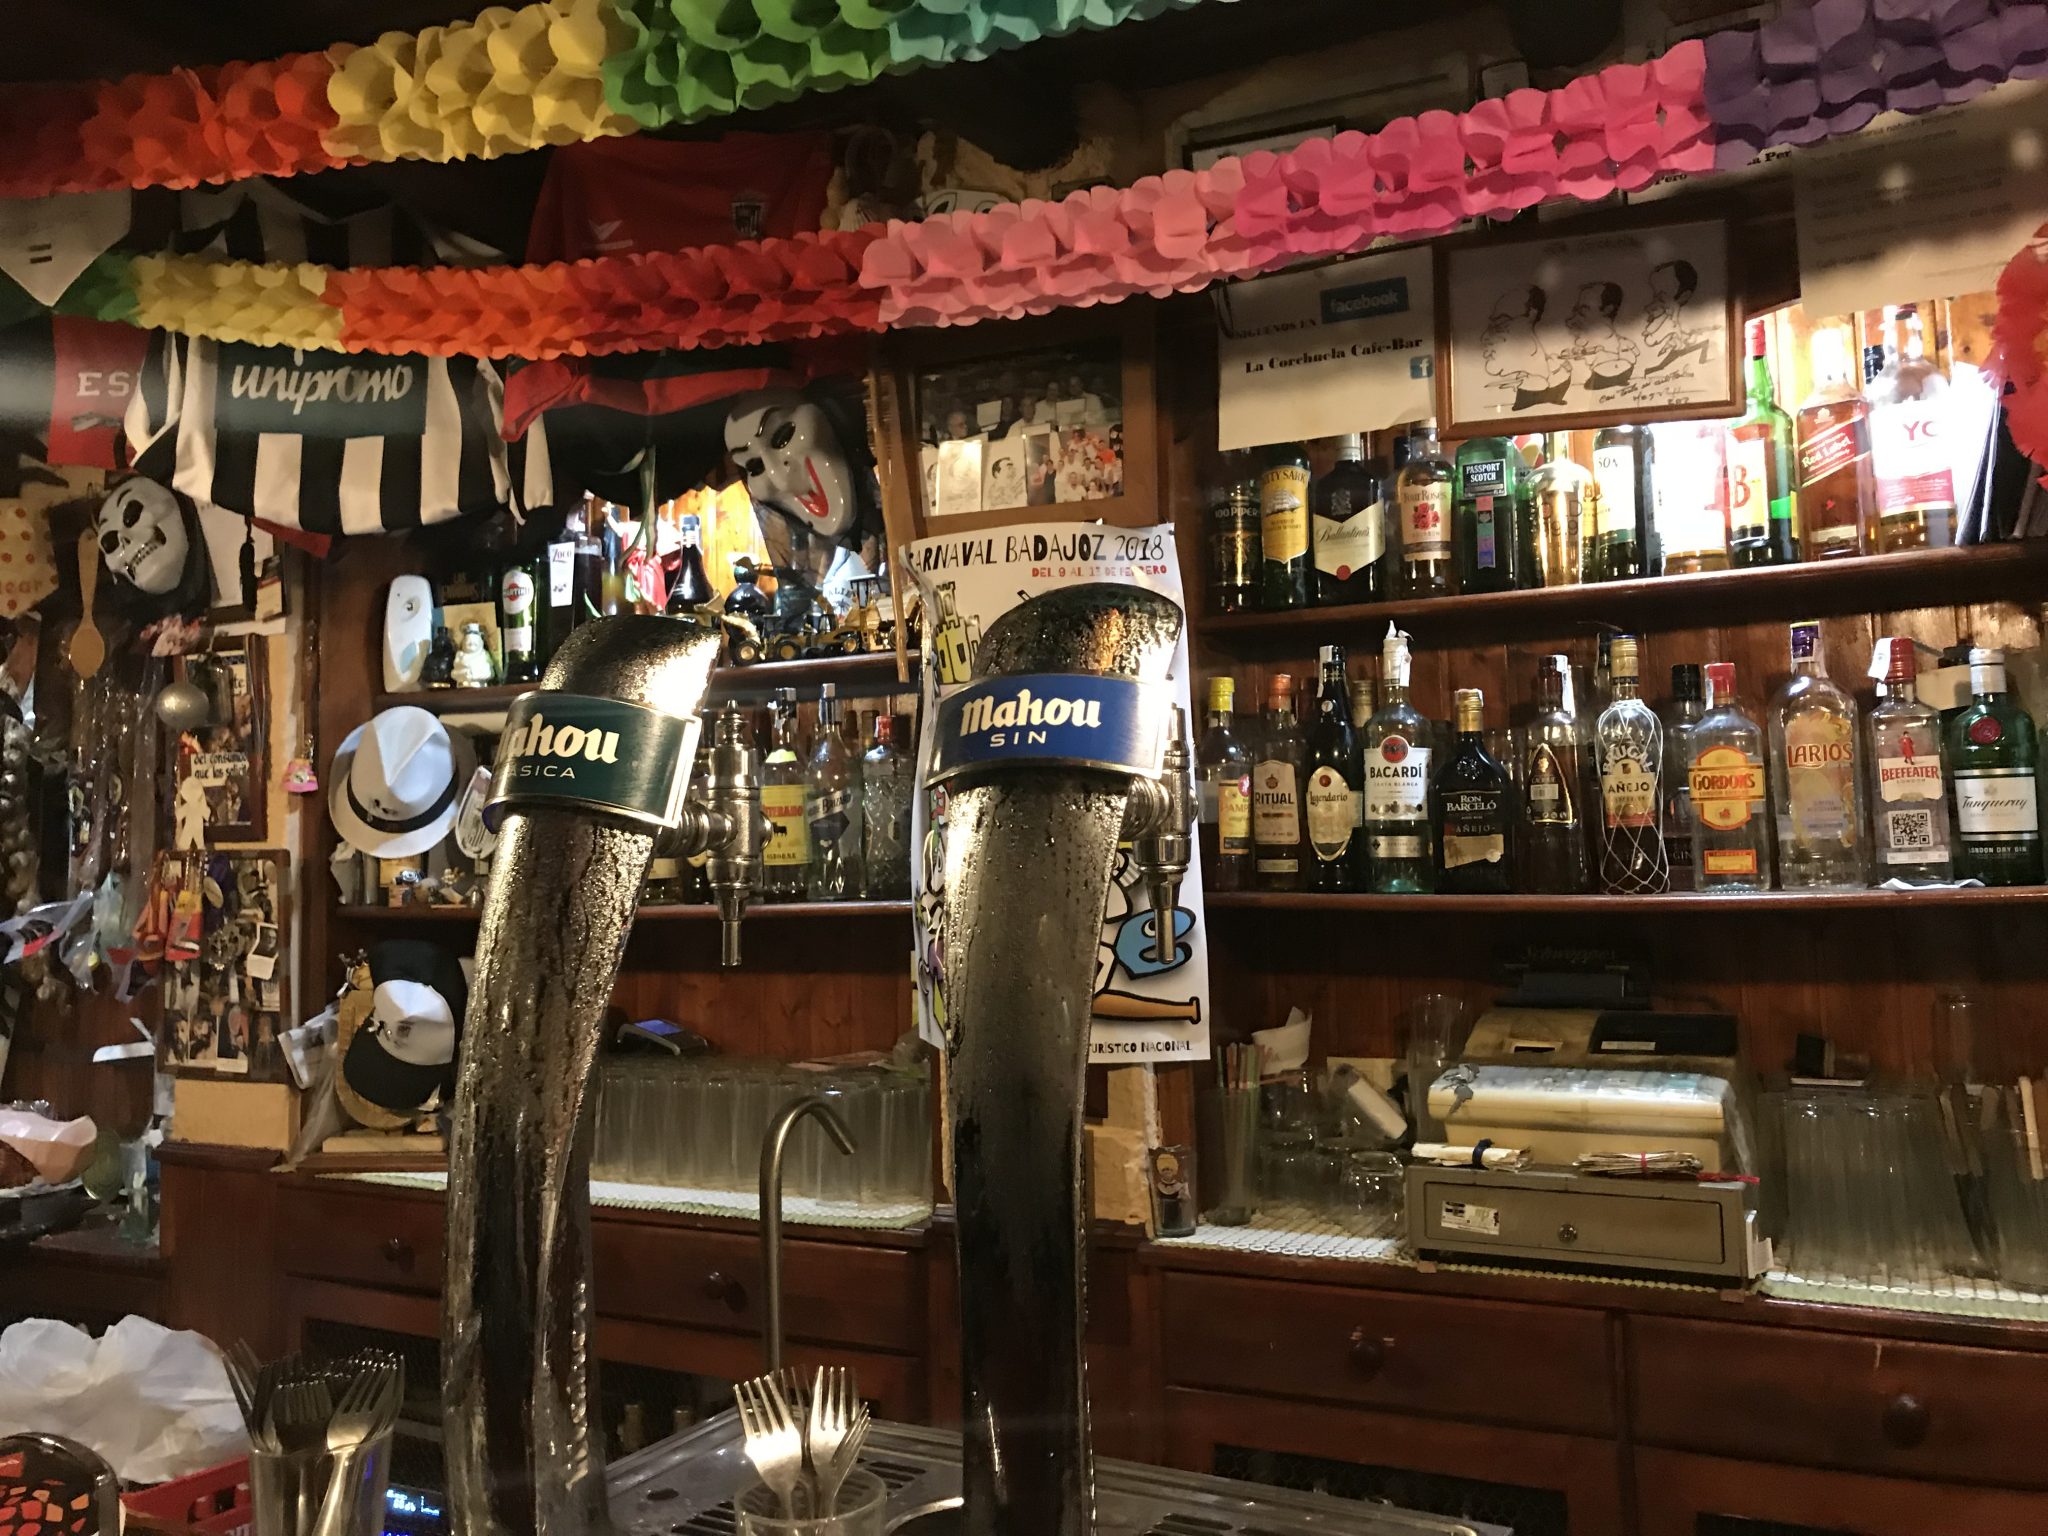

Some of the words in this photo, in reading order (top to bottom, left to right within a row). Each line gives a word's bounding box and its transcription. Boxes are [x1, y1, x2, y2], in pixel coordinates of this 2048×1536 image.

[1764, 150, 1792, 163] Per
[1330, 289, 1399, 314] facebook
[1245, 361, 1265, 374] La
[1267, 346, 1346, 370] Corchuela
[76, 371, 138, 397] ES
[231, 348, 413, 415] unipromo
[1801, 450, 1823, 468] Red
[1823, 436, 1853, 457] Label
[1282, 469, 1307, 483] SARK
[1465, 462, 1501, 475] PASSPORT
[1470, 471, 1497, 483] SCOTCH
[1214, 508, 1229, 519] 100
[1005, 533, 1106, 562] BADAJOZ
[1115, 534, 1164, 562] 2018
[1031, 567, 1053, 578] DEL
[1058, 566, 1066, 577] 9
[1070, 567, 1083, 577] AL
[1105, 567, 1117, 577] DE
[1120, 564, 1168, 577] FEERO
[959, 688, 1102, 737] Mahou
[989, 730, 1047, 748] SIN
[1787, 743, 1854, 768] LARIOS
[1369, 762, 1422, 779] BACARDÍ
[1881, 765, 1940, 783] BEEFEATER
[1607, 781, 1650, 793] AÑEJO
[1255, 791, 1295, 805] RITUAL
[1309, 791, 1348, 807] Legendario
[1446, 799, 1497, 812] BARCELÓ
[1460, 794, 1482, 803] RON
[1962, 795, 2028, 812] Tanqueray
[1968, 846, 1994, 854] LONDON
[1996, 846, 2012, 854] DRY
[2014, 845, 2027, 853] GIN
[1141, 1041, 1193, 1053] NACIONAL
